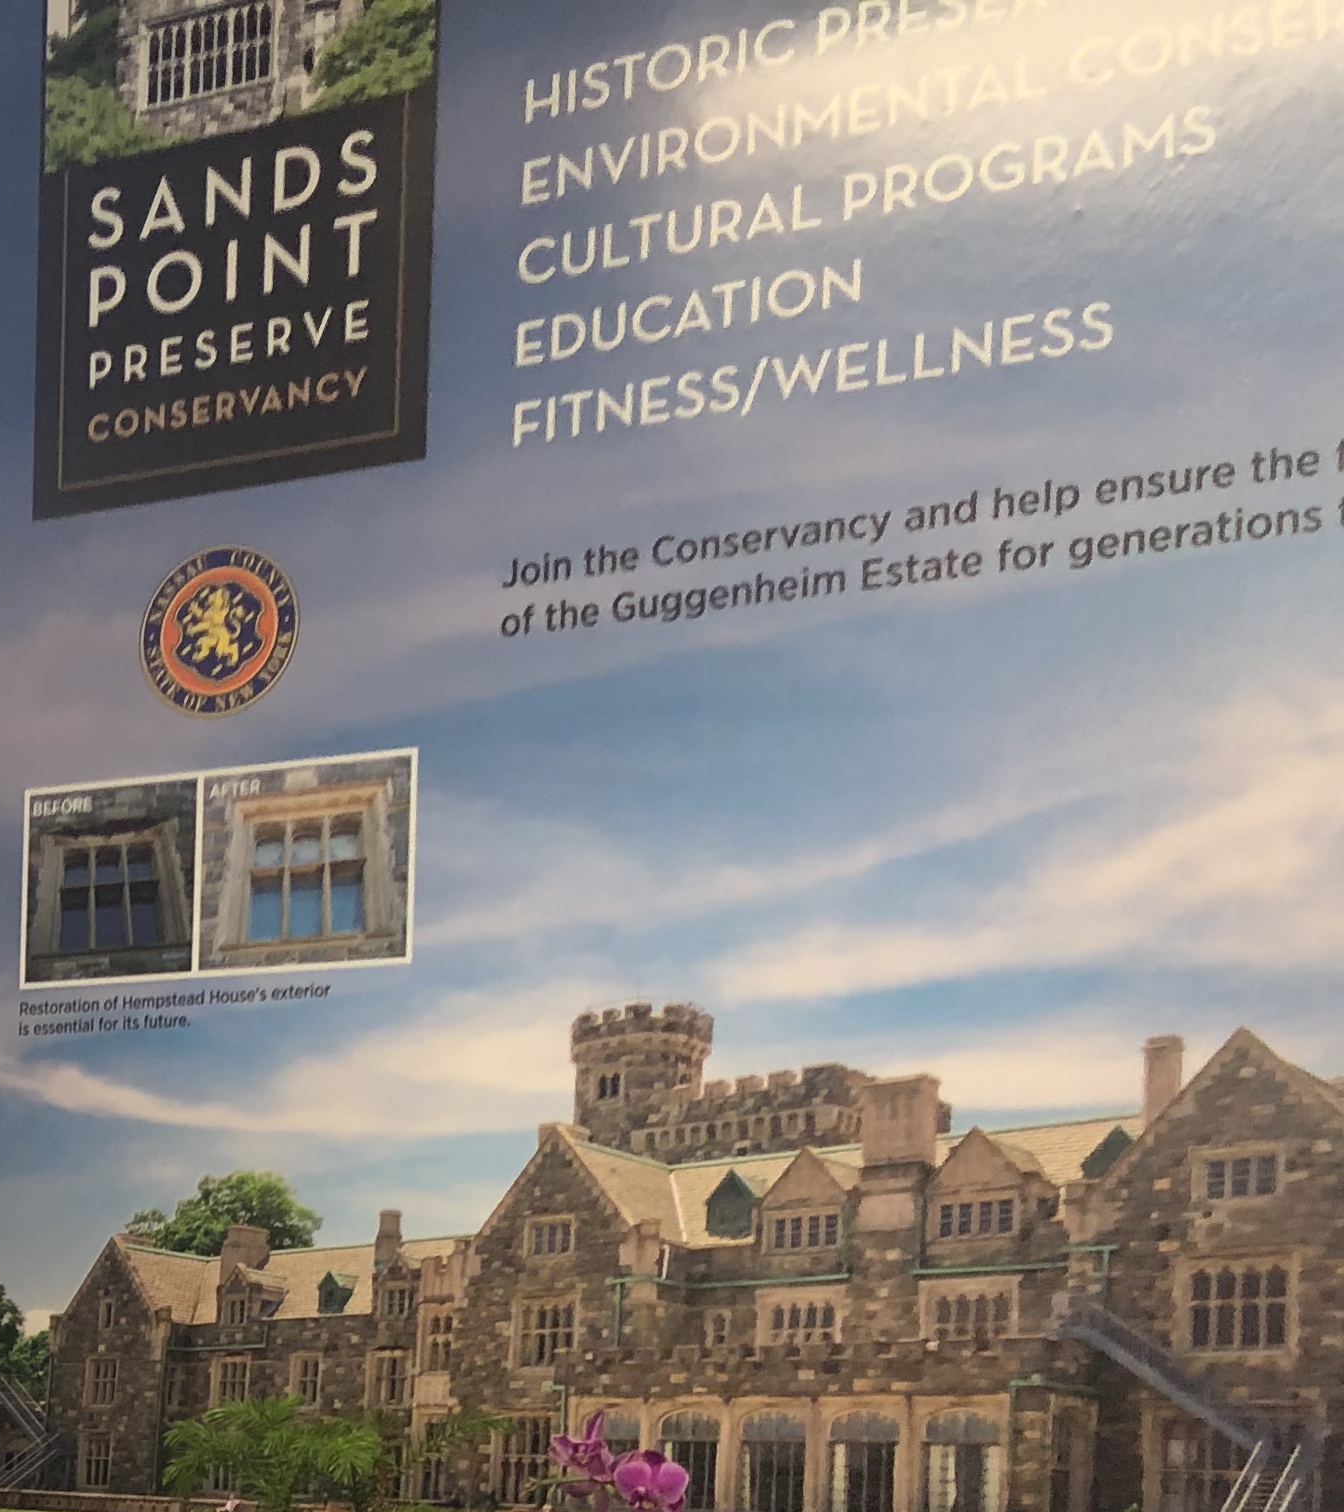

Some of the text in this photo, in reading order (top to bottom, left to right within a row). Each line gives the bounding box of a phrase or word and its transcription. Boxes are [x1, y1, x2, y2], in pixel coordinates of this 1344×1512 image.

[524, 17, 796, 125] HISTORIC
[87, 129, 378, 249] SANDS
[520, 54, 1049, 208] ENVIRONMENTAL
[518, 105, 1218, 285] CULTURAL PROGRAMS
[87, 209, 378, 328] POINT
[514, 257, 864, 368] EDUCATION
[88, 299, 370, 391] PRESERVE
[511, 302, 1114, 448] FITNESS/WELLNESS
[87, 366, 368, 444] CONSERVANCY
[500, 599, 535, 638] of
[544, 591, 600, 632] the
[611, 565, 847, 626] Guggenheim
[860, 545, 983, 592] Estate
[998, 533, 1055, 574] for
[1067, 501, 1322, 571] generations
[502, 555, 573, 590] Join
[582, 541, 640, 576] the
[650, 507, 891, 567] Conservancy
[904, 490, 978, 533] and
[991, 463, 1081, 519] help
[1094, 458, 1234, 506] ensure
[1250, 441, 1320, 485] the
[18, 1013, 191, 1036] is essential for its future.
[19, 983, 331, 1017] Restoration of Hempstead House's exterior
